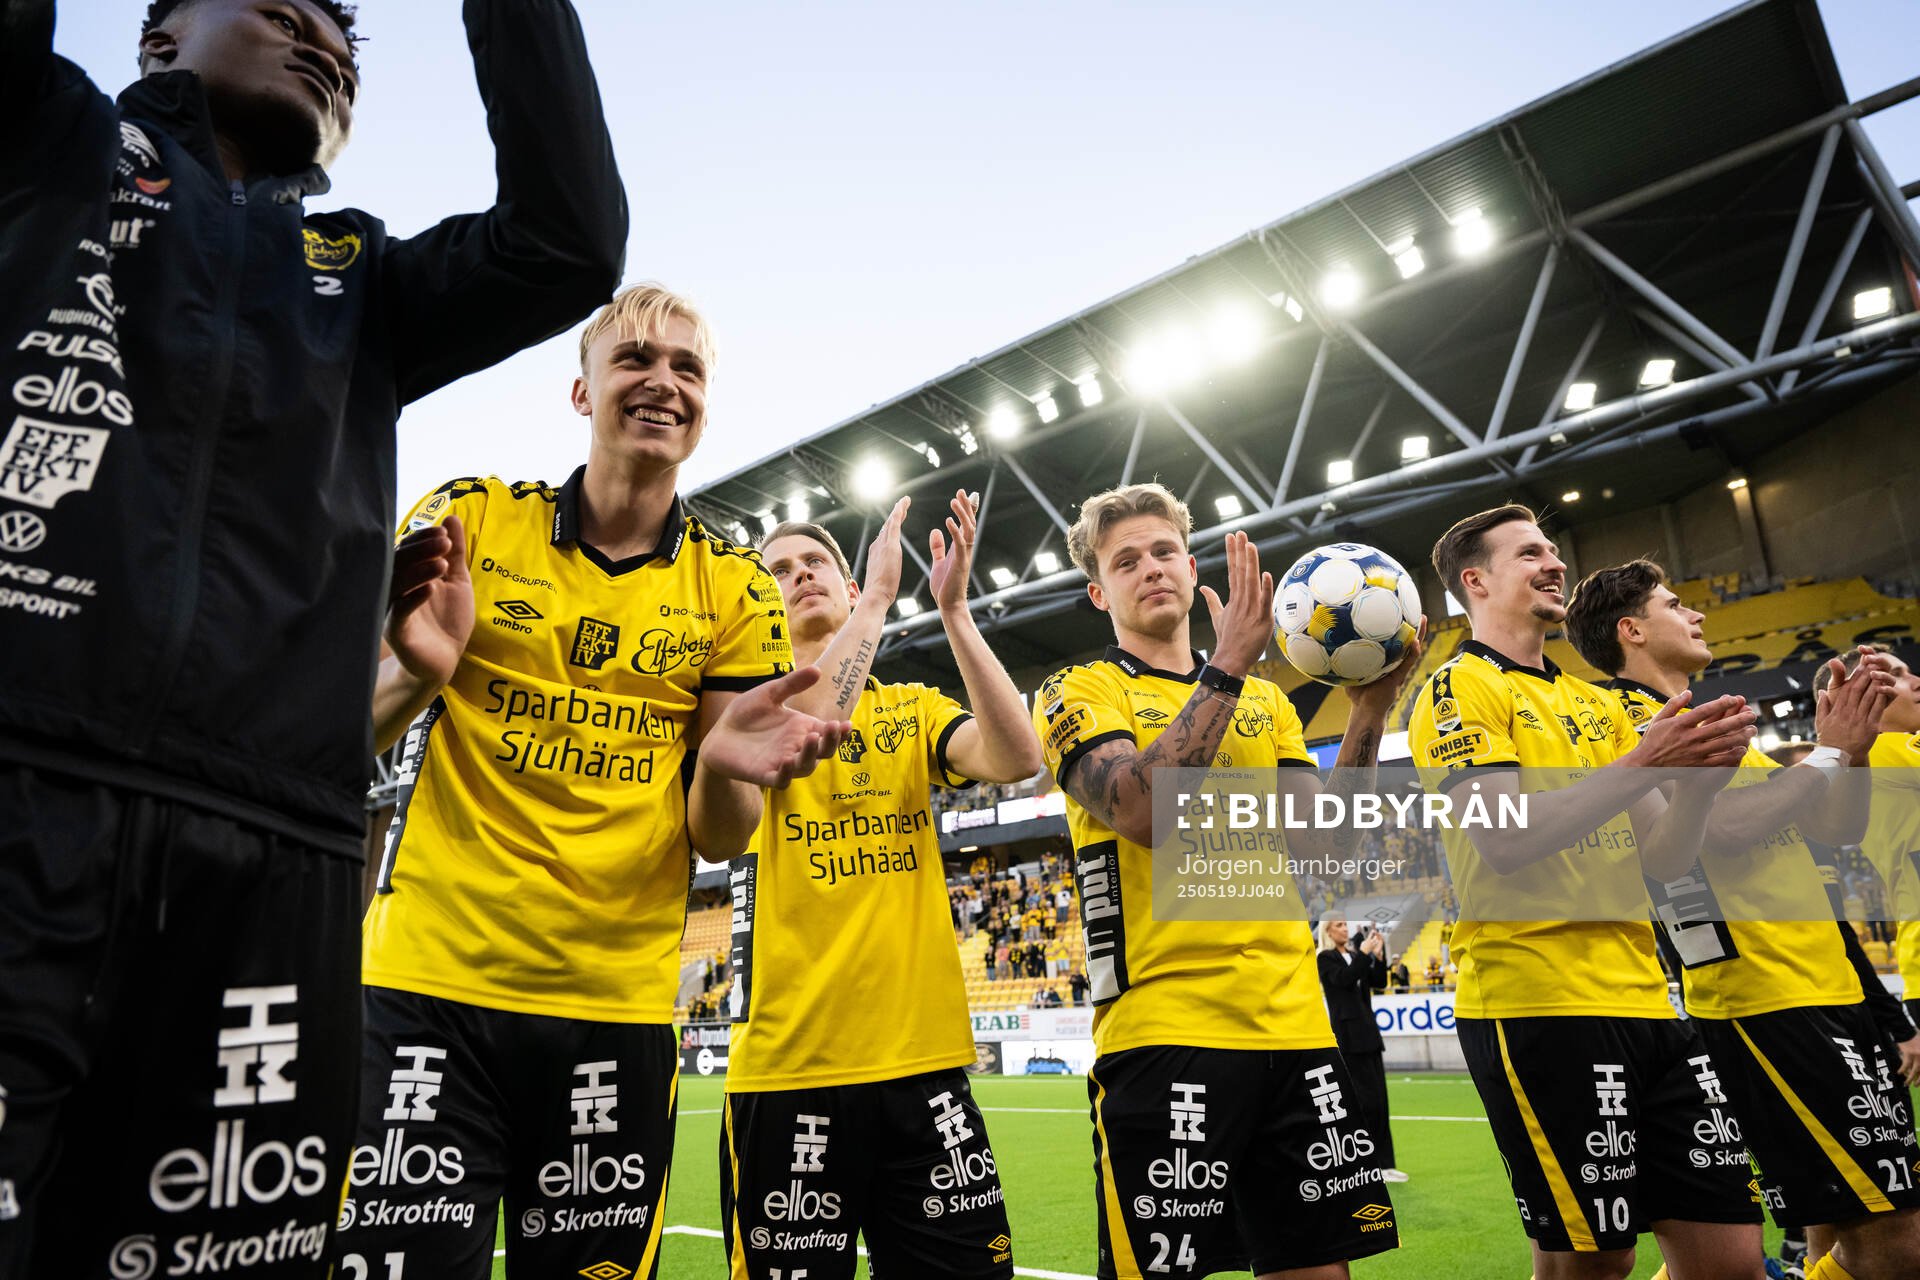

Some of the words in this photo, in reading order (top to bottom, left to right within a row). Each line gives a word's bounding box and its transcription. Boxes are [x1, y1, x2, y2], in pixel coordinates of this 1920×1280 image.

[110, 217, 144, 243] ut
[312, 275, 344, 296] 2
[12, 366, 133, 426] ellos
[20, 424, 90, 456] EFF
[8, 449, 91, 482] EKT
[493, 616, 533, 634] umbro
[581, 620, 612, 640] EFF
[573, 650, 596, 666] IV
[578, 634, 615, 655] EKT
[631, 629, 712, 677] Elfsborg
[485, 679, 676, 741] Sparbanken
[1046, 709, 1085, 749] UNIBET
[1430, 733, 1482, 758] UNIBET
[495, 730, 654, 784] Sjuhärad
[971, 1014, 1020, 1031] EAB
[1374, 999, 1456, 1031] orde
[1693, 1108, 1743, 1144] ello
[150, 1118, 327, 1213] ellos
[350, 1128, 466, 1187] ellos
[1306, 1127, 1375, 1170] ellos
[538, 1143, 646, 1198] ellos
[929, 1147, 997, 1190] ellos
[1147, 1147, 1229, 1190] ellos
[360, 1196, 475, 1229] Skrotfrag
[551, 1203, 649, 1233] Skrotfrag
[763, 1179, 841, 1222] ellos
[1593, 1197, 1630, 1232] 10
[773, 1228, 848, 1252] Skrotfrag
[1360, 1220, 1393, 1234] umbro
[167, 1219, 328, 1275] Skrotfrag
[1147, 1232, 1197, 1273] 24
